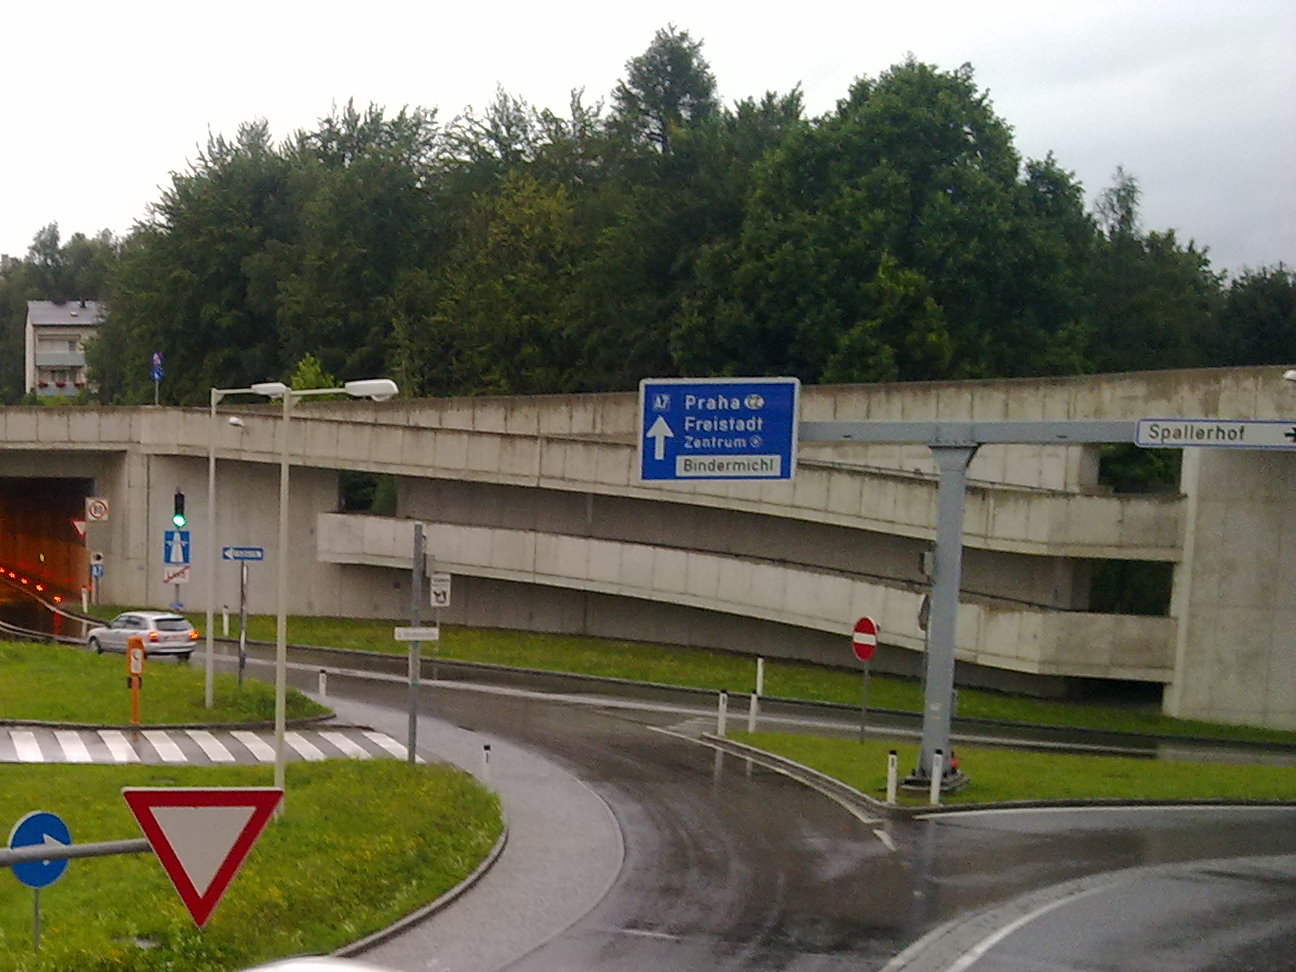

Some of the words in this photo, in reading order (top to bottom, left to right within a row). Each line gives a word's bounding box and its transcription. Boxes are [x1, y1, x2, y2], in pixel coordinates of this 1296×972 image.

[684, 394, 741, 410] Praha
[684, 416, 763, 432] Freistadt
[1148, 423, 1245, 444] Spallerhof
[684, 435, 747, 449] Zentrum
[683, 458, 774, 472] Bindermichl
